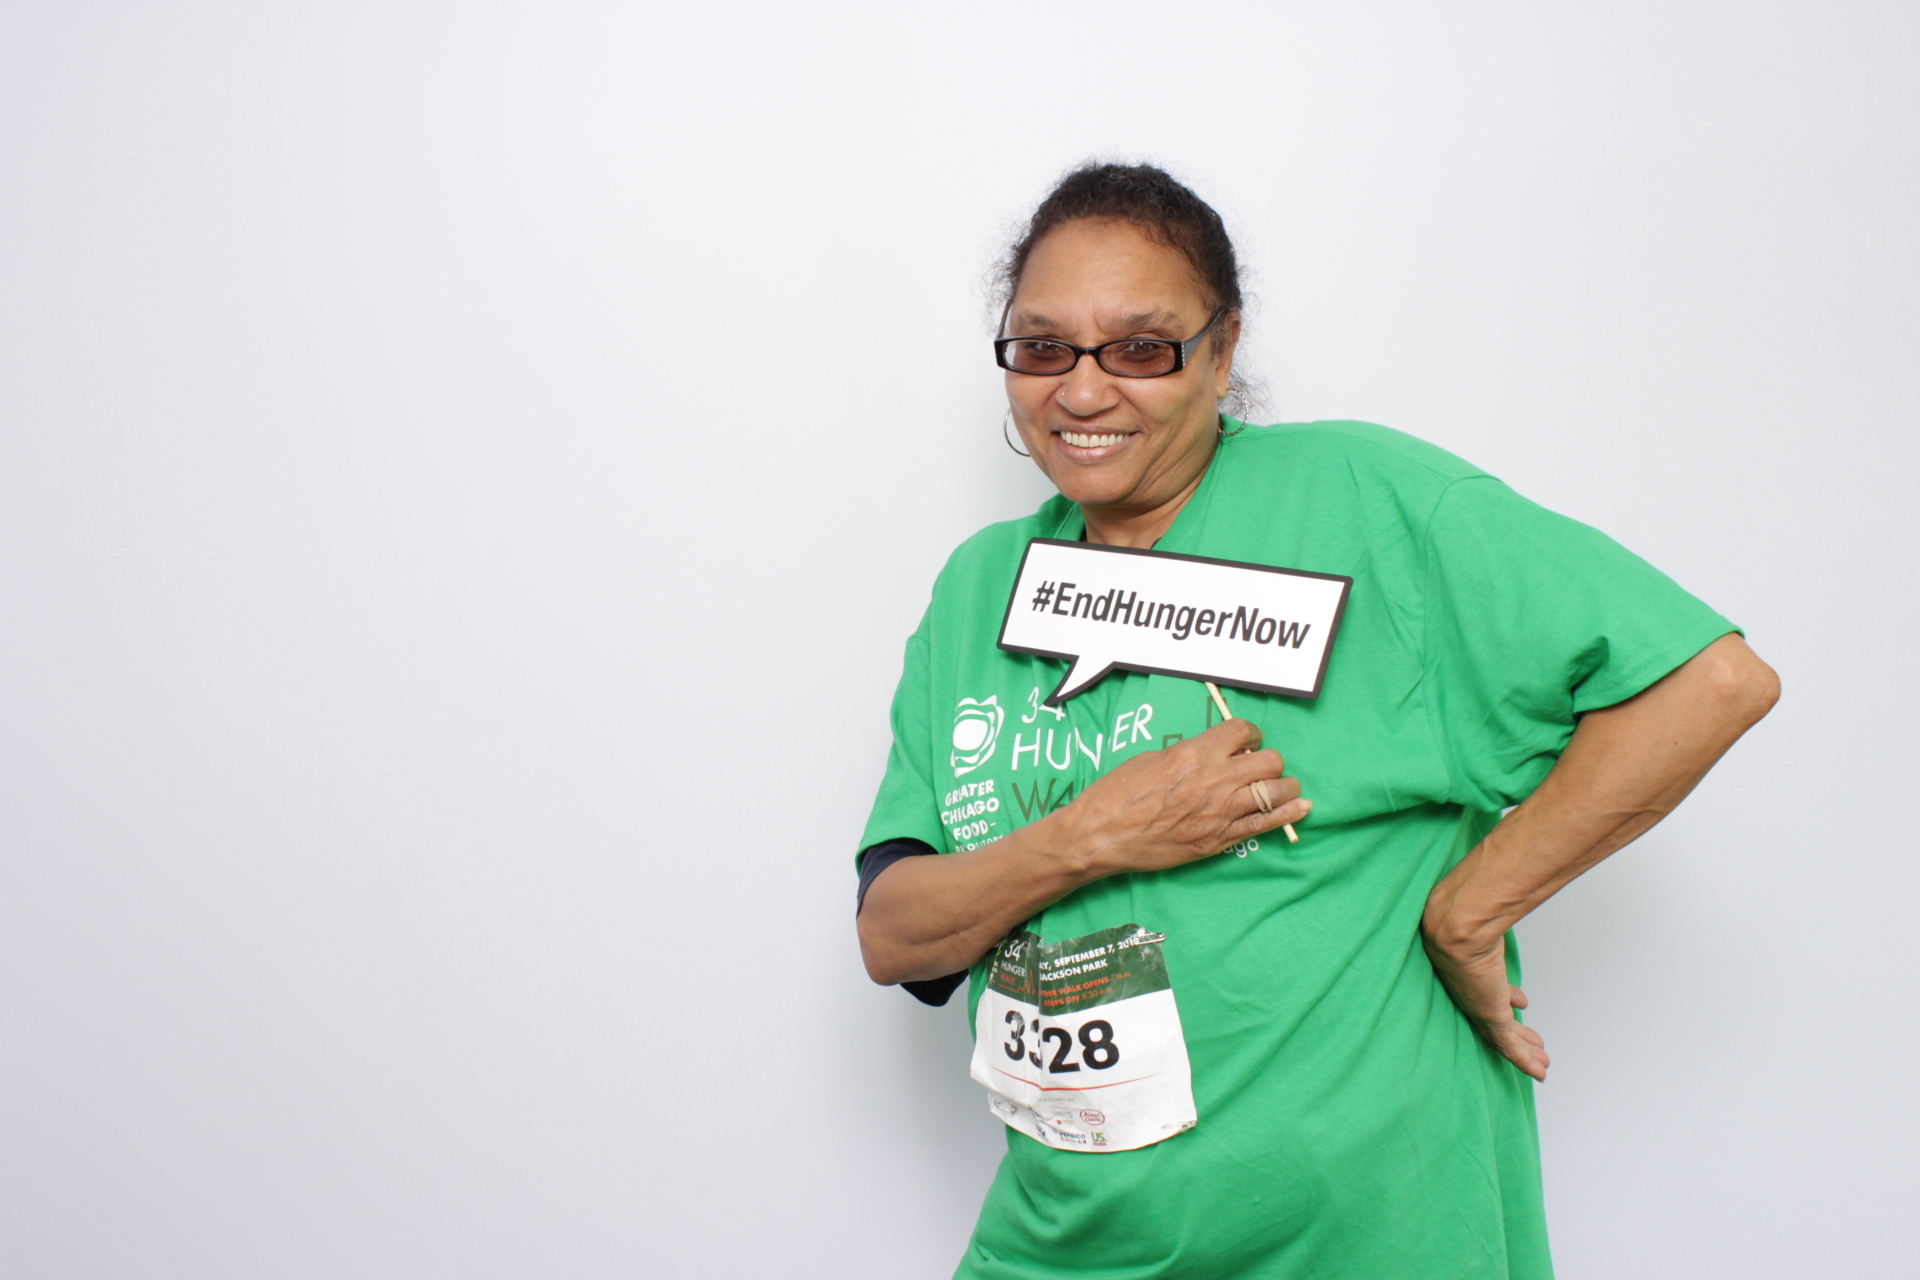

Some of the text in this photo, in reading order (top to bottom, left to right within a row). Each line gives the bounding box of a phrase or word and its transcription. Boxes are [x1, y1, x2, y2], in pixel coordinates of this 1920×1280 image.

[1031, 580, 1312, 649] #EndHungerNow
[1011, 703, 1153, 772] HUNER
[941, 797, 1000, 825] CHICAGO
[1054, 946, 1107, 968] SEPTEMBER
[1107, 943, 1116, 954] 7,
[1082, 958, 1109, 973] PARK
[1001, 960, 1026, 977] HUNGER
[1058, 984, 1082, 995] WALK
[1083, 976, 1110, 990] OPENS
[1043, 997, 1065, 1007] STEPS
[1065, 995, 1080, 1004] OFF
[1081, 989, 1099, 1001] 8:30
